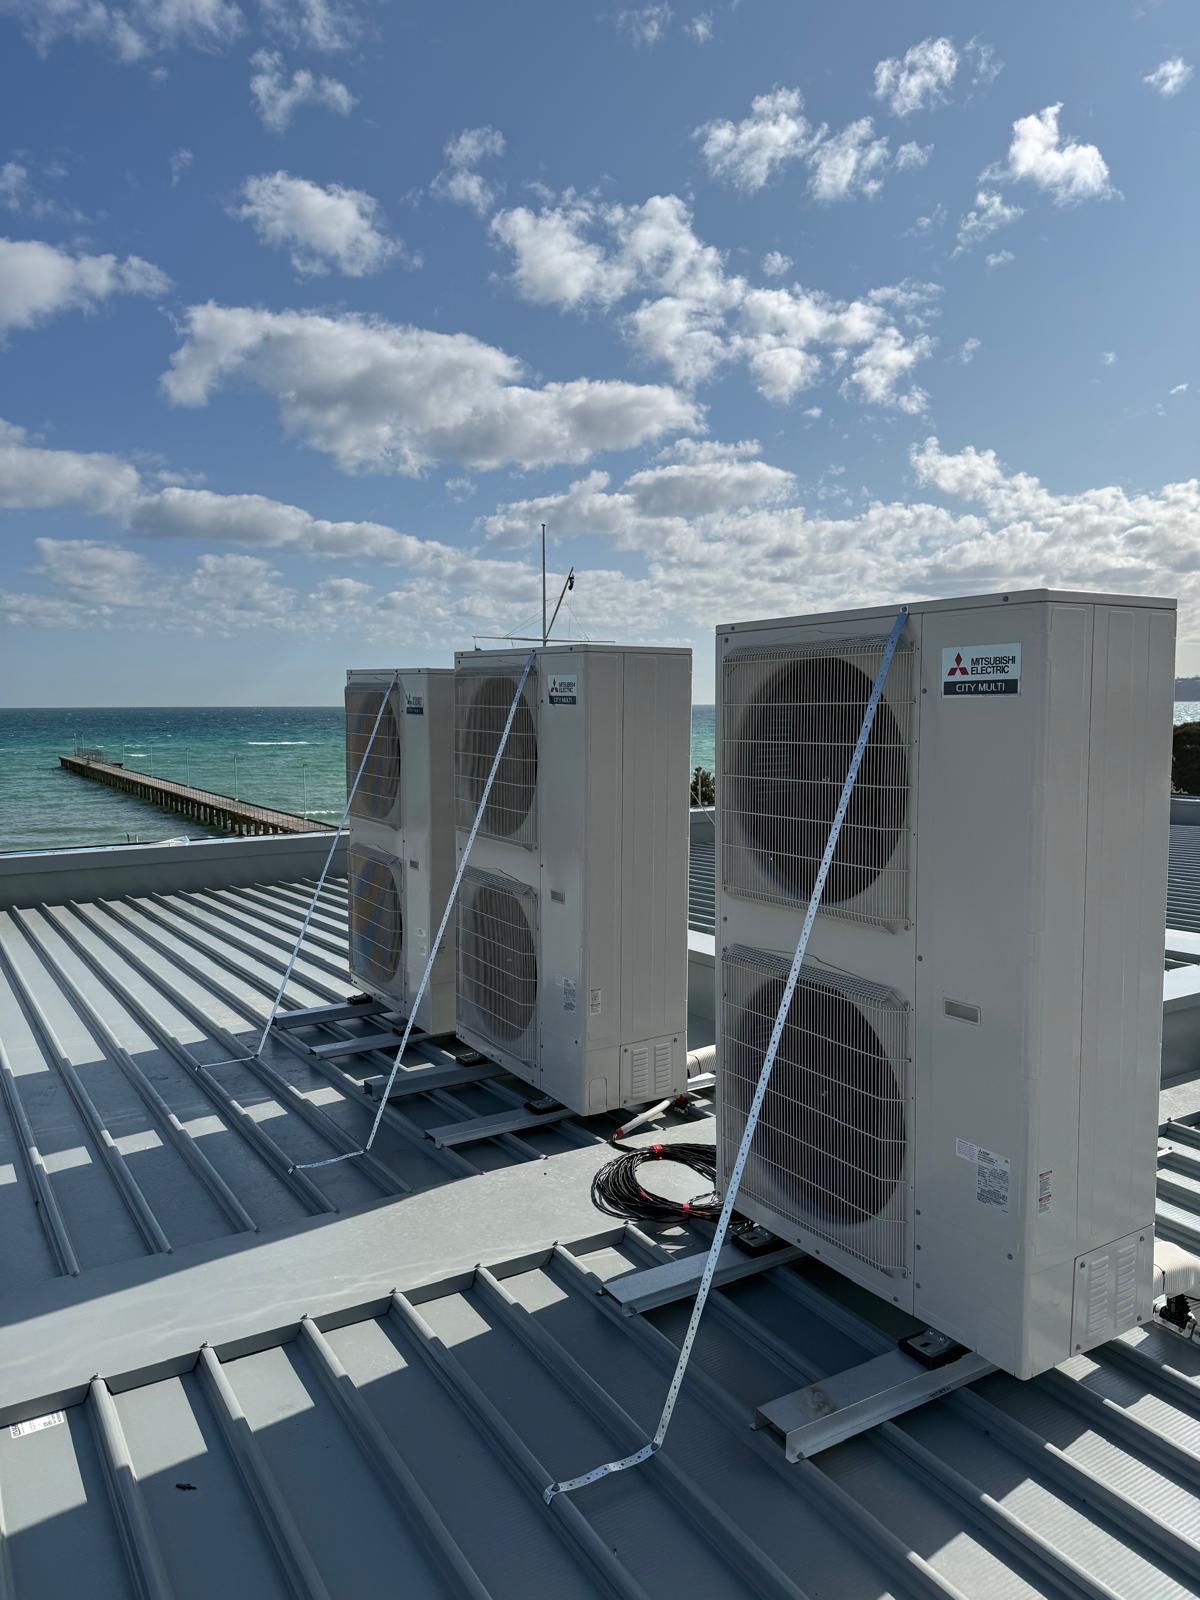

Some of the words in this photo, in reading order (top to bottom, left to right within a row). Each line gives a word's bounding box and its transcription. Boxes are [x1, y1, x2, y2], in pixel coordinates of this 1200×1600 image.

[970, 656, 1016, 666] MITSUBISHI
[970, 666, 1010, 675] ELECTRIC
[956, 683, 976, 692] CITY
[978, 682, 1005, 692] MULTI
